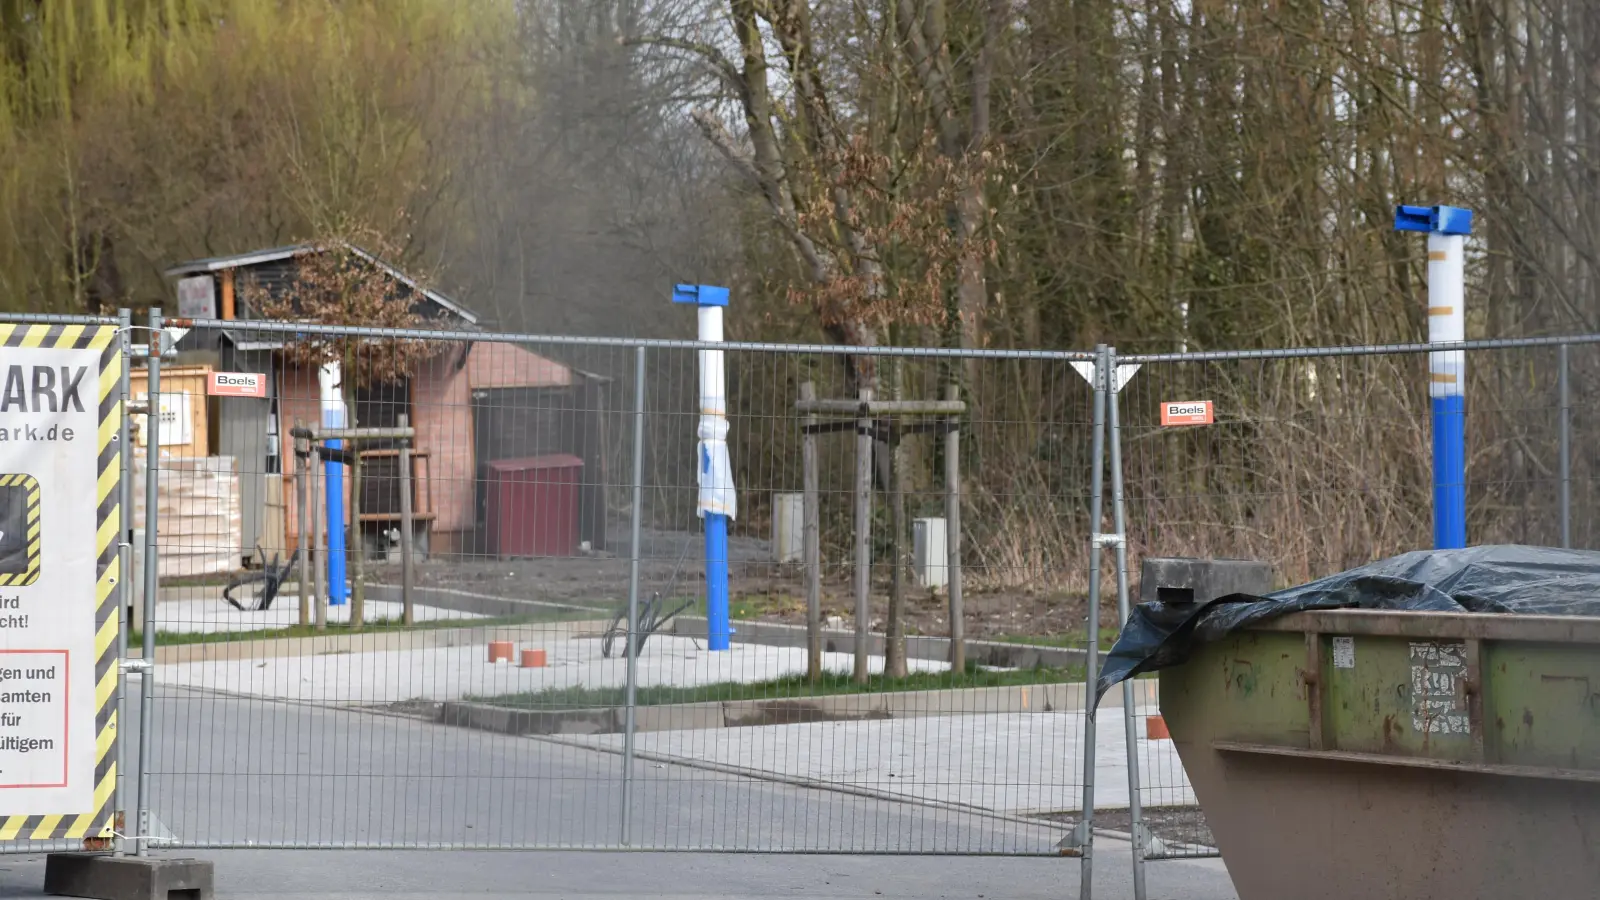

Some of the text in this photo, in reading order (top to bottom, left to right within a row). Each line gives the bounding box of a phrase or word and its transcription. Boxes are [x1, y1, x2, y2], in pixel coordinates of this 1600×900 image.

[217, 376, 256, 385] Boels
[1, 365, 88, 412] ARK
[1169, 405, 1204, 414] Boels
[26, 666, 55, 680] und
[1, 712, 21, 726] für
